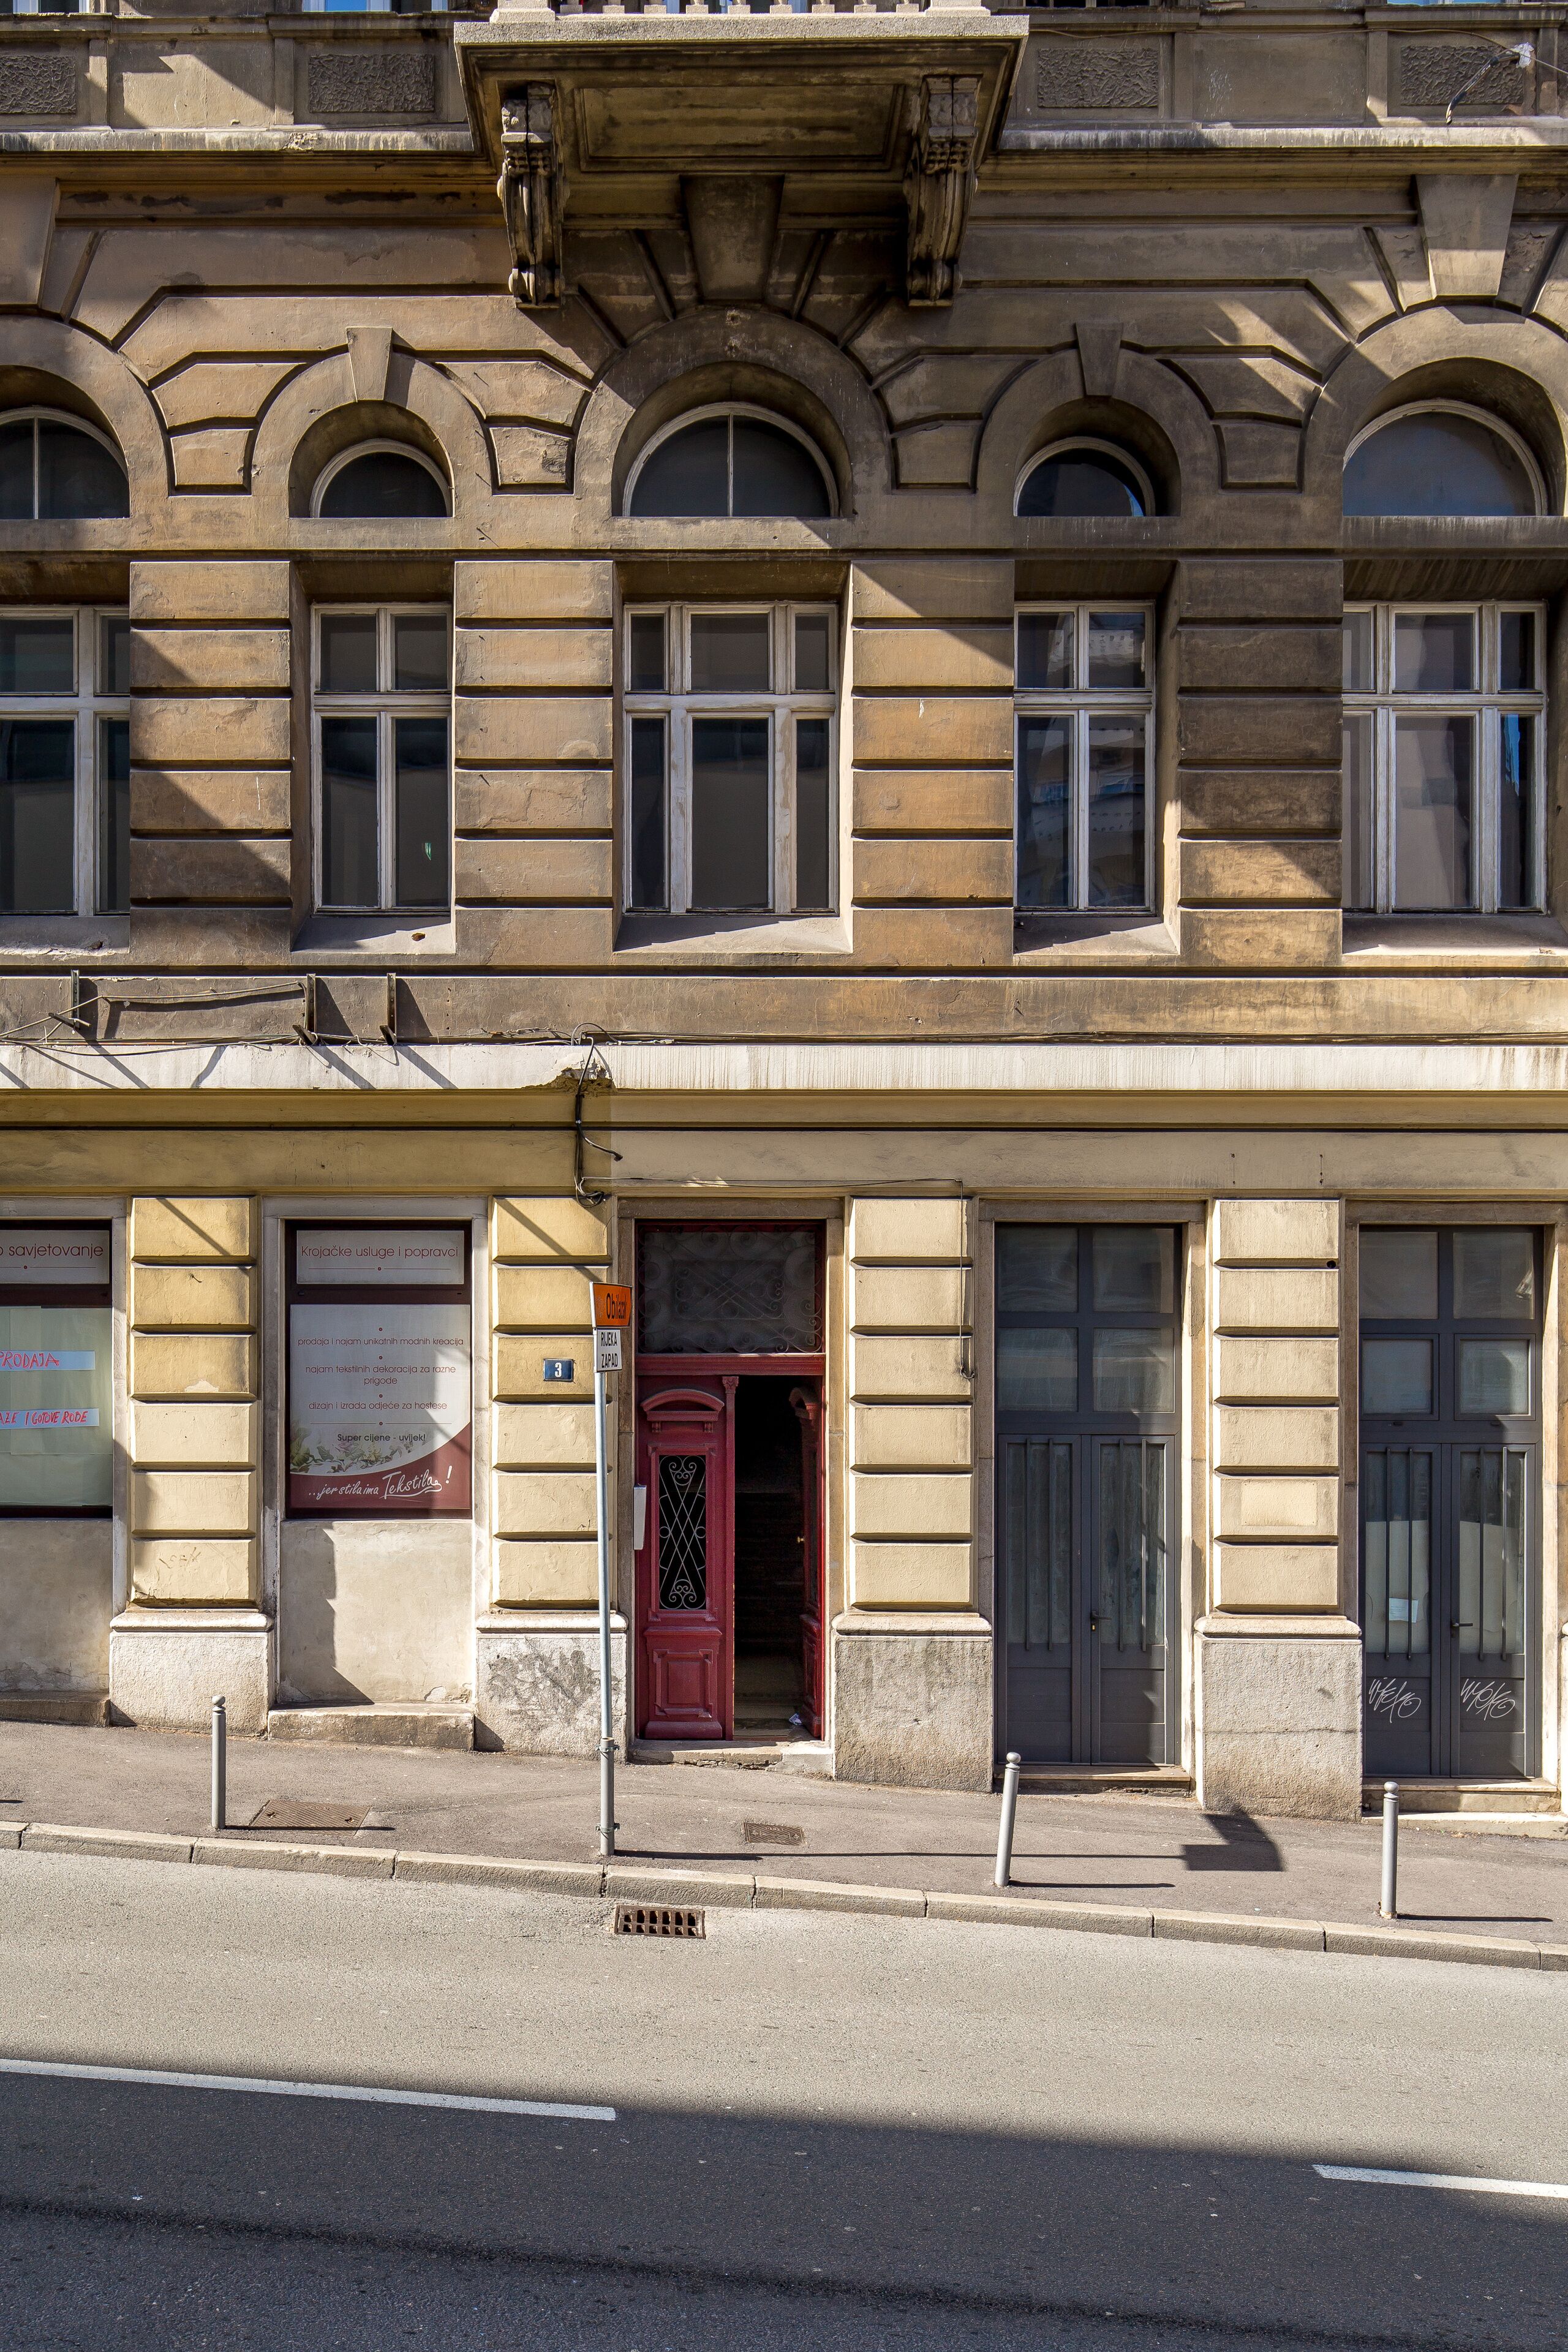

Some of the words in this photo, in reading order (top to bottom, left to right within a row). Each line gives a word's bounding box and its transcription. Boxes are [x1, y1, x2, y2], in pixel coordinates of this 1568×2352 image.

[9, 1243, 104, 1259] savjetovanje
[301, 1245, 352, 1259] Krojačke
[356, 1246, 395, 1259] usluge
[404, 1246, 459, 1259] popravci
[298, 1338, 330, 1346] prodaja
[335, 1338, 361, 1346] najam
[432, 1338, 464, 1346] kreacija
[600, 1332, 617, 1347] RIJEKA
[601, 1353, 618, 1368] ZAPAD
[305, 1365, 333, 1374] najam
[336, 1365, 371, 1373] tekstilnih
[372, 1365, 418, 1374] dekoracija
[554, 1362, 562, 1378] 3
[364, 1376, 398, 1387] prigode
[308, 1401, 333, 1411] dizajn
[368, 1401, 400, 1411] odjeće
[31, 1411, 61, 1425] GOTOVE
[61, 1411, 88, 1424] ROBE
[337, 1433, 362, 1443] Super
[364, 1433, 391, 1443] cijene
[399, 1433, 426, 1443] uvijek!
[338, 1481, 362, 1495] stila
[363, 1484, 379, 1494] ima
